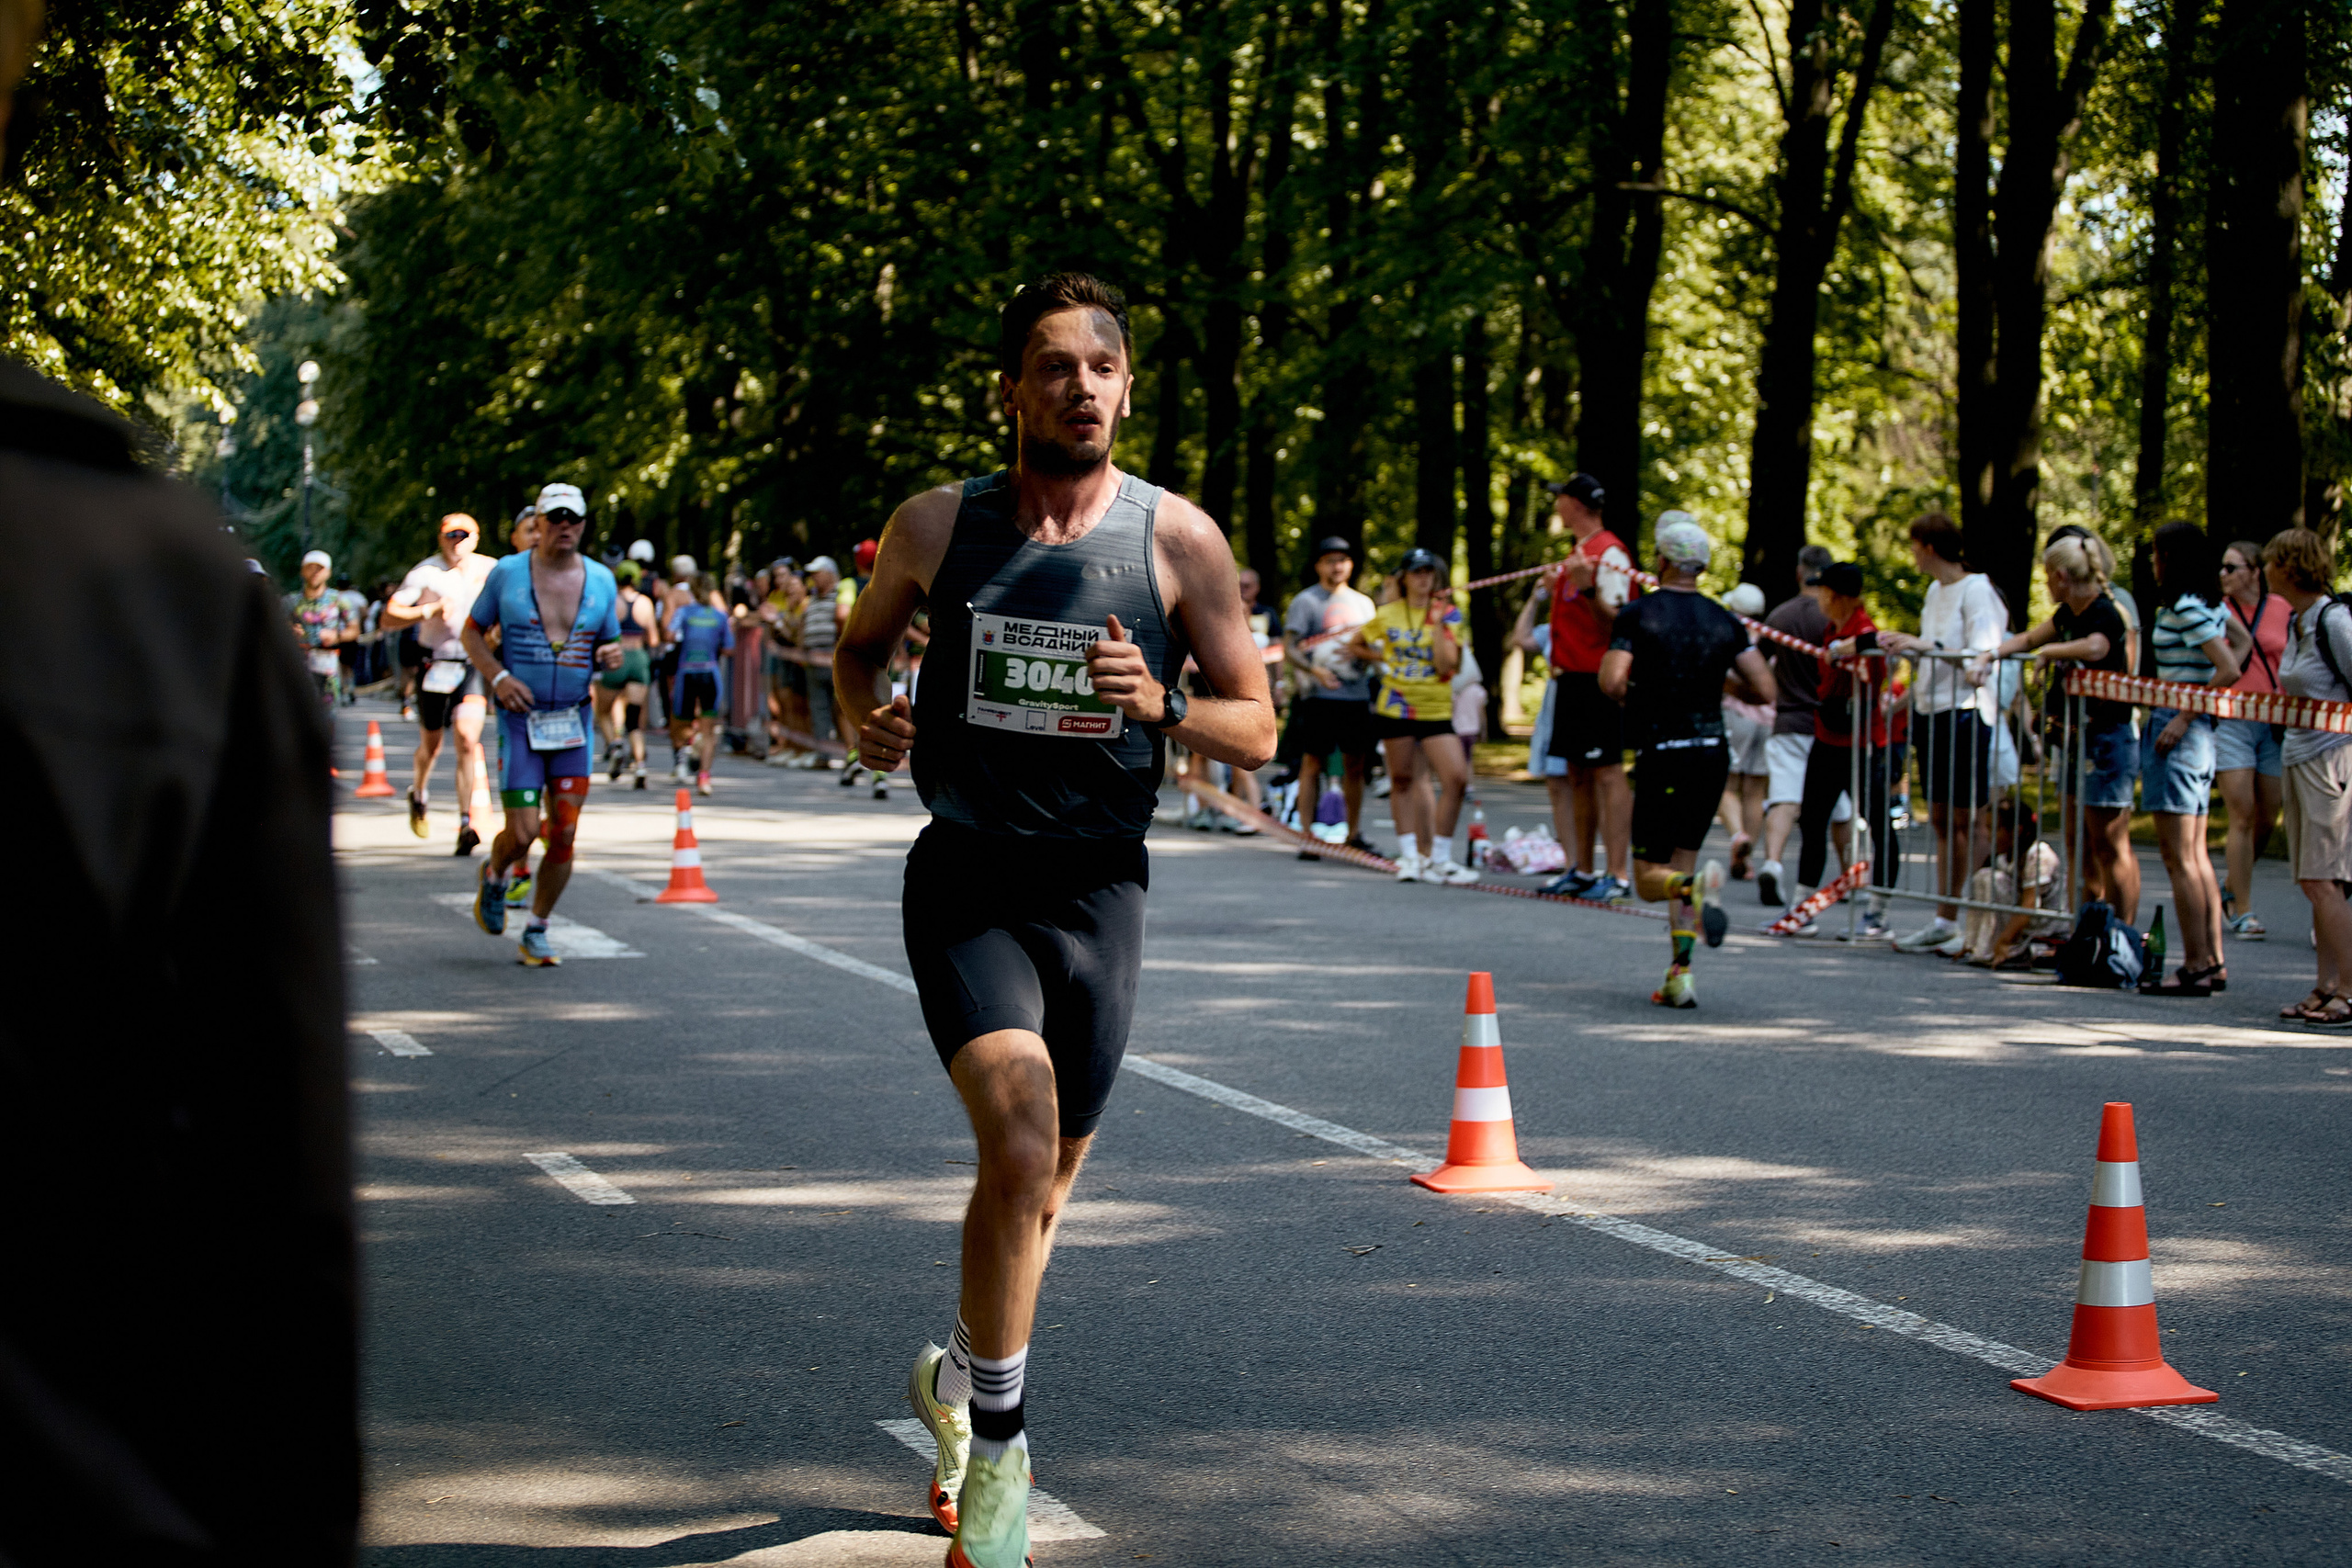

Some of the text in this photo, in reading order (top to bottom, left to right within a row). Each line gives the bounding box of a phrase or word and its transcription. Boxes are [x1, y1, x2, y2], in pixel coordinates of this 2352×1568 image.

[1003, 621, 1099, 641] МЕДНЫЙ
[1002, 634, 1091, 652] ВСАДНИ
[1018, 698, 1080, 711] GravitySport
[1072, 719, 1107, 730] МАГНИТ
